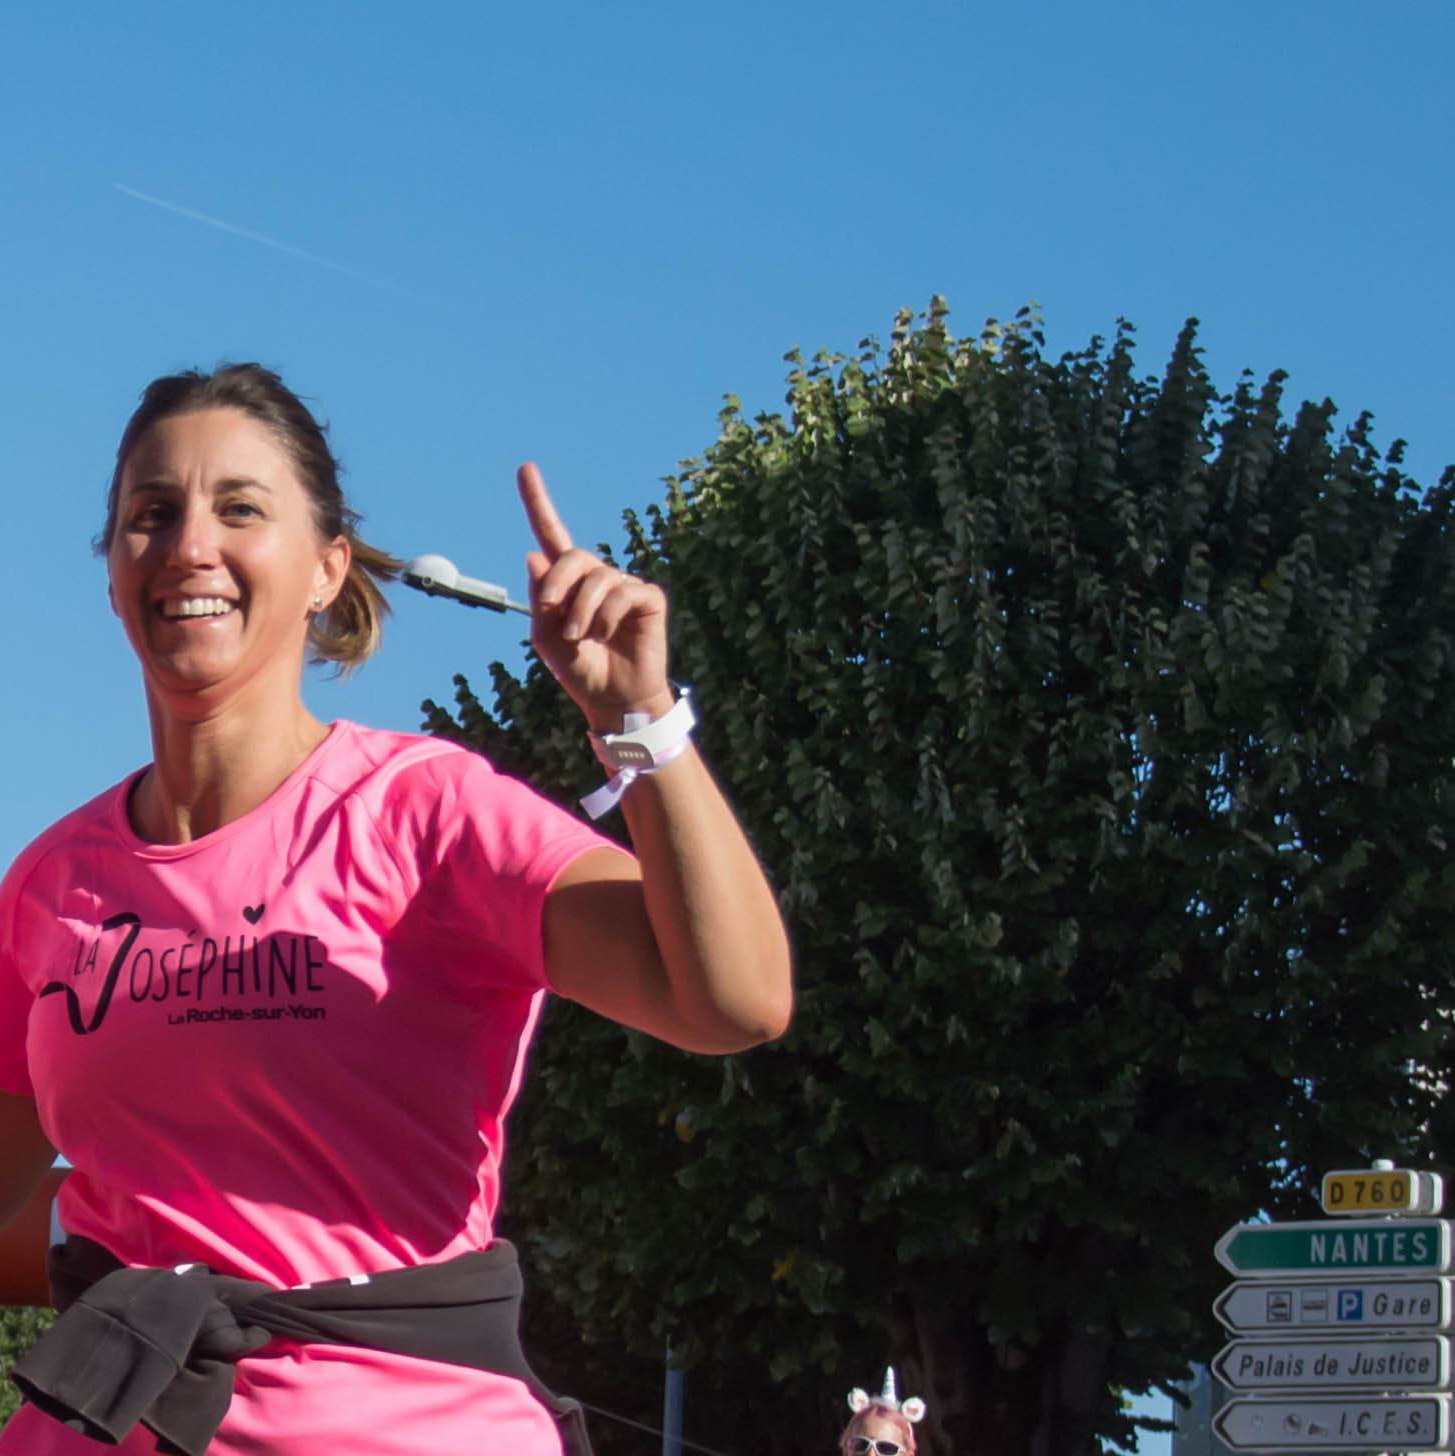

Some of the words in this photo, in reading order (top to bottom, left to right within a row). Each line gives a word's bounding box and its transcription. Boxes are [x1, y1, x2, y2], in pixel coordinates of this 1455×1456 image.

[73, 939, 99, 976] LA
[168, 1012, 185, 1025] La
[187, 1004, 326, 1023] Roche-sur-Yon
[1331, 1182, 1344, 1204] D
[1354, 1180, 1404, 1202] 760
[1310, 1232, 1428, 1263] NANTES
[1373, 1292, 1431, 1316] Gare
[1239, 1354, 1303, 1378] Palais
[1314, 1353, 1339, 1376] de
[1348, 1352, 1430, 1375] Justice
